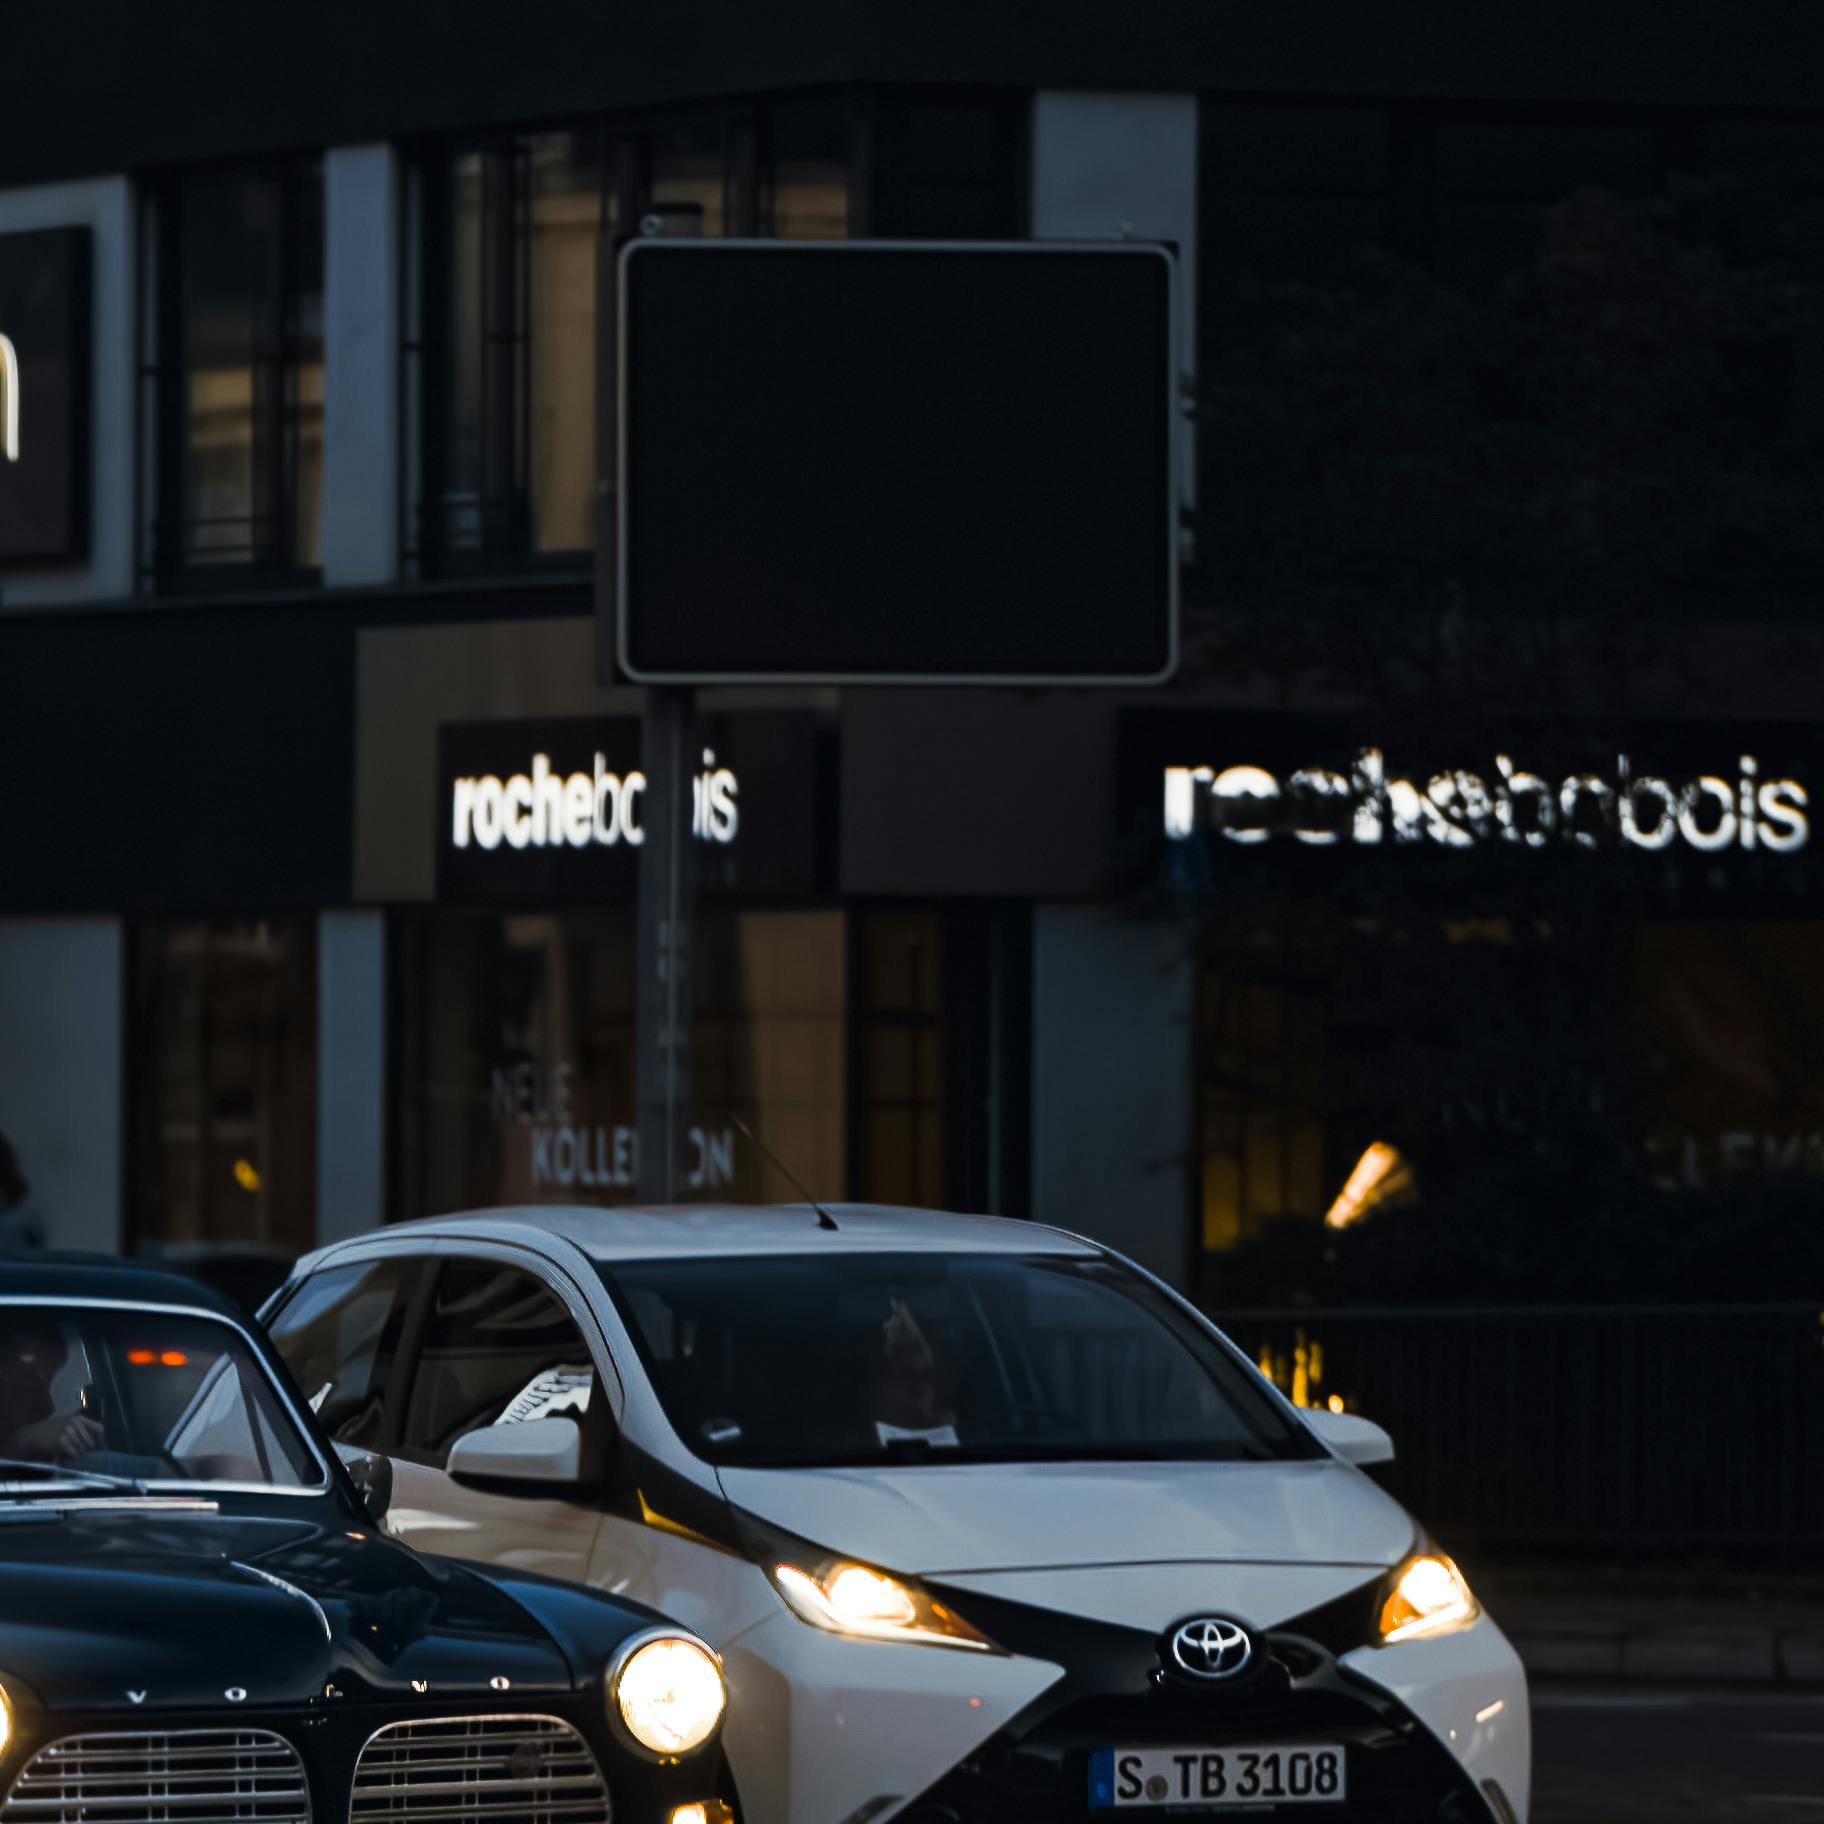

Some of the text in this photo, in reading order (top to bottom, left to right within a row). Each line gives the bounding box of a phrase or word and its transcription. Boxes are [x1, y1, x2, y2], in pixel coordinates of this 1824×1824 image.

[452, 748, 739, 848] rochebois
[531, 1124, 735, 1186] KOLLEON
[1116, 1751, 1340, 1801] S TB 3108
